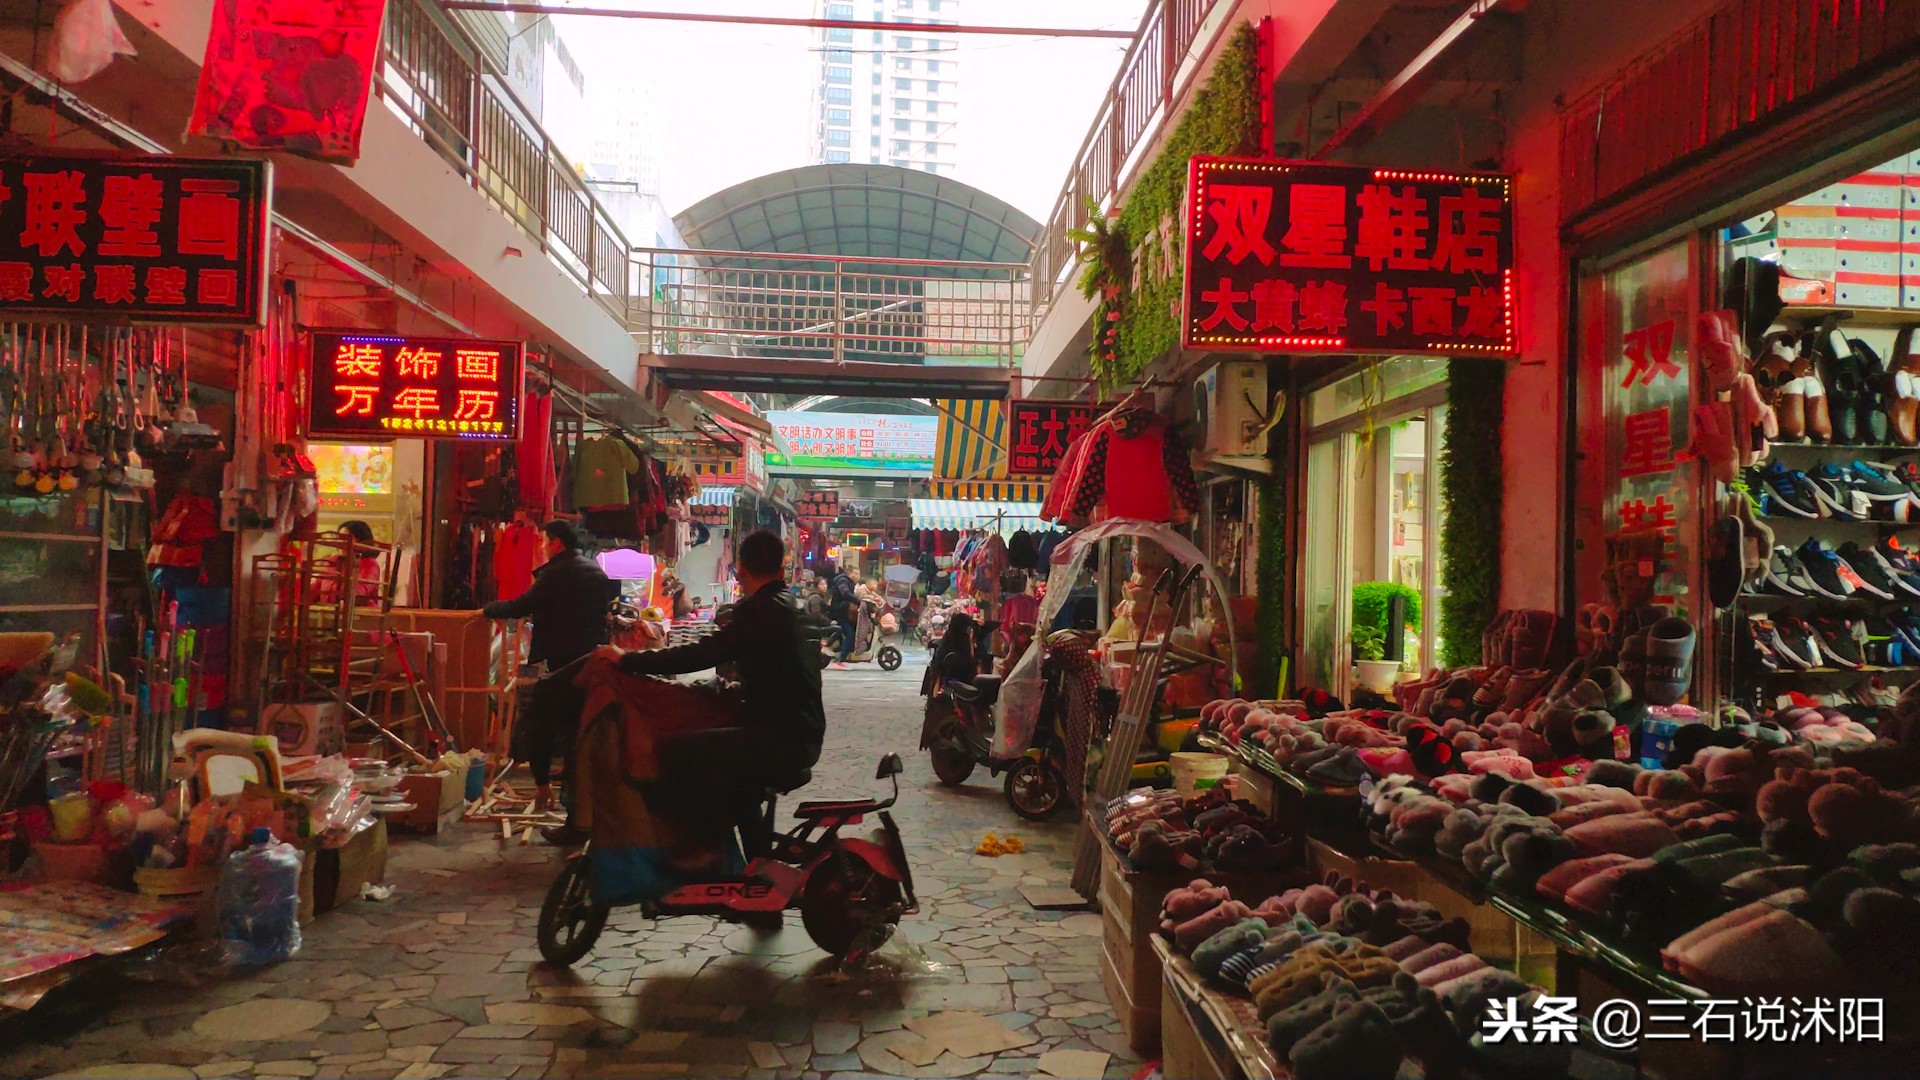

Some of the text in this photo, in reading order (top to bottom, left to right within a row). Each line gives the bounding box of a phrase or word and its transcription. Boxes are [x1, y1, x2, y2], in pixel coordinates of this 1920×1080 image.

[0, 169, 240, 261] 联壁画
[1202, 183, 1501, 274] 双星鞋店
[1200, 277, 1502, 338] 大黄蜂 卡西龙
[335, 343, 500, 382] 装饰画
[334, 384, 499, 419] 万年历
